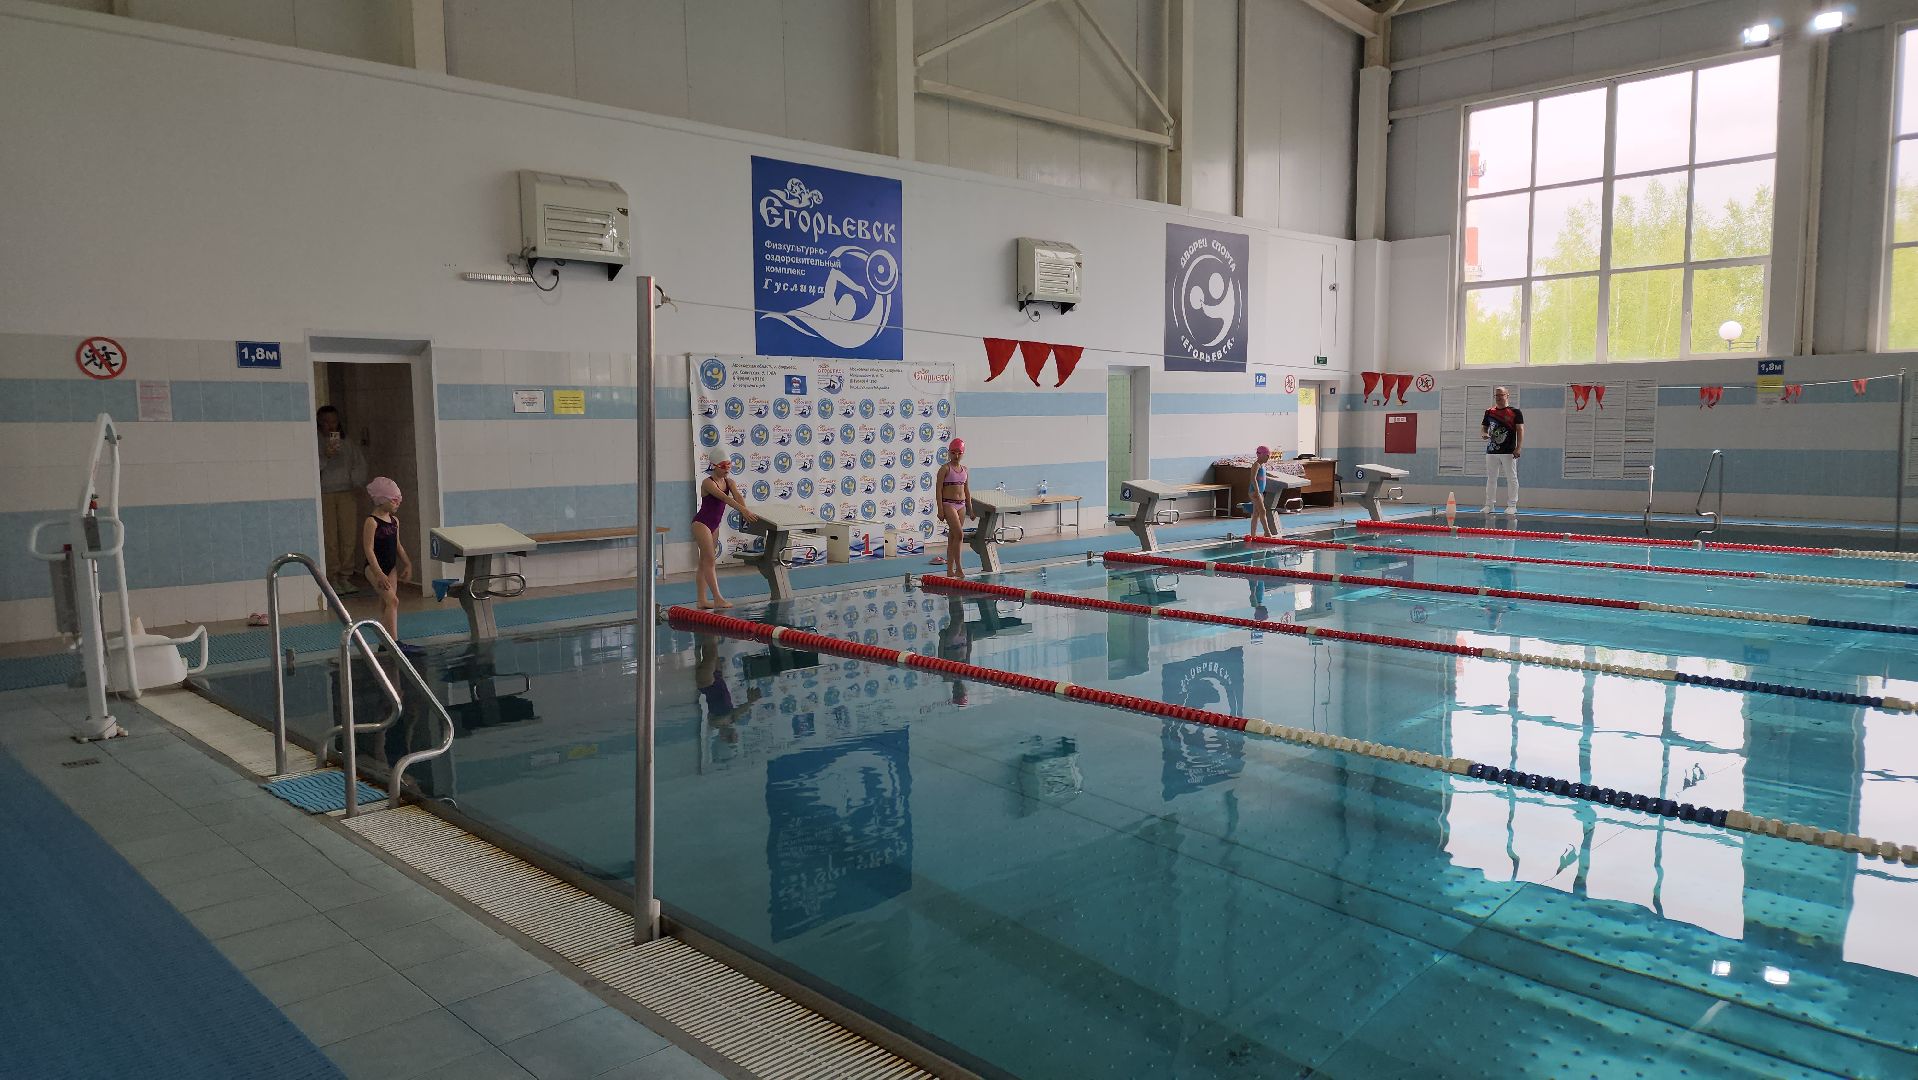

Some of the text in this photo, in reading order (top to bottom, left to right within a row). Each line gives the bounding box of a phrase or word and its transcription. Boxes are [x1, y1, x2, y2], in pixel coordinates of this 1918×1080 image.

[764, 240, 828, 255] Физкультурно-
[1180, 238, 1236, 272] ДВОРЕЦ СПОРТА
[765, 253, 842, 269] оздоровительный
[765, 265, 806, 276] комплекс
[763, 278, 825, 295] Гуслица
[241, 346, 278, 363] 1,8м
[1357, 470, 1363, 479] 6
[861, 532, 874, 555] 1
[906, 536, 915, 551] 3
